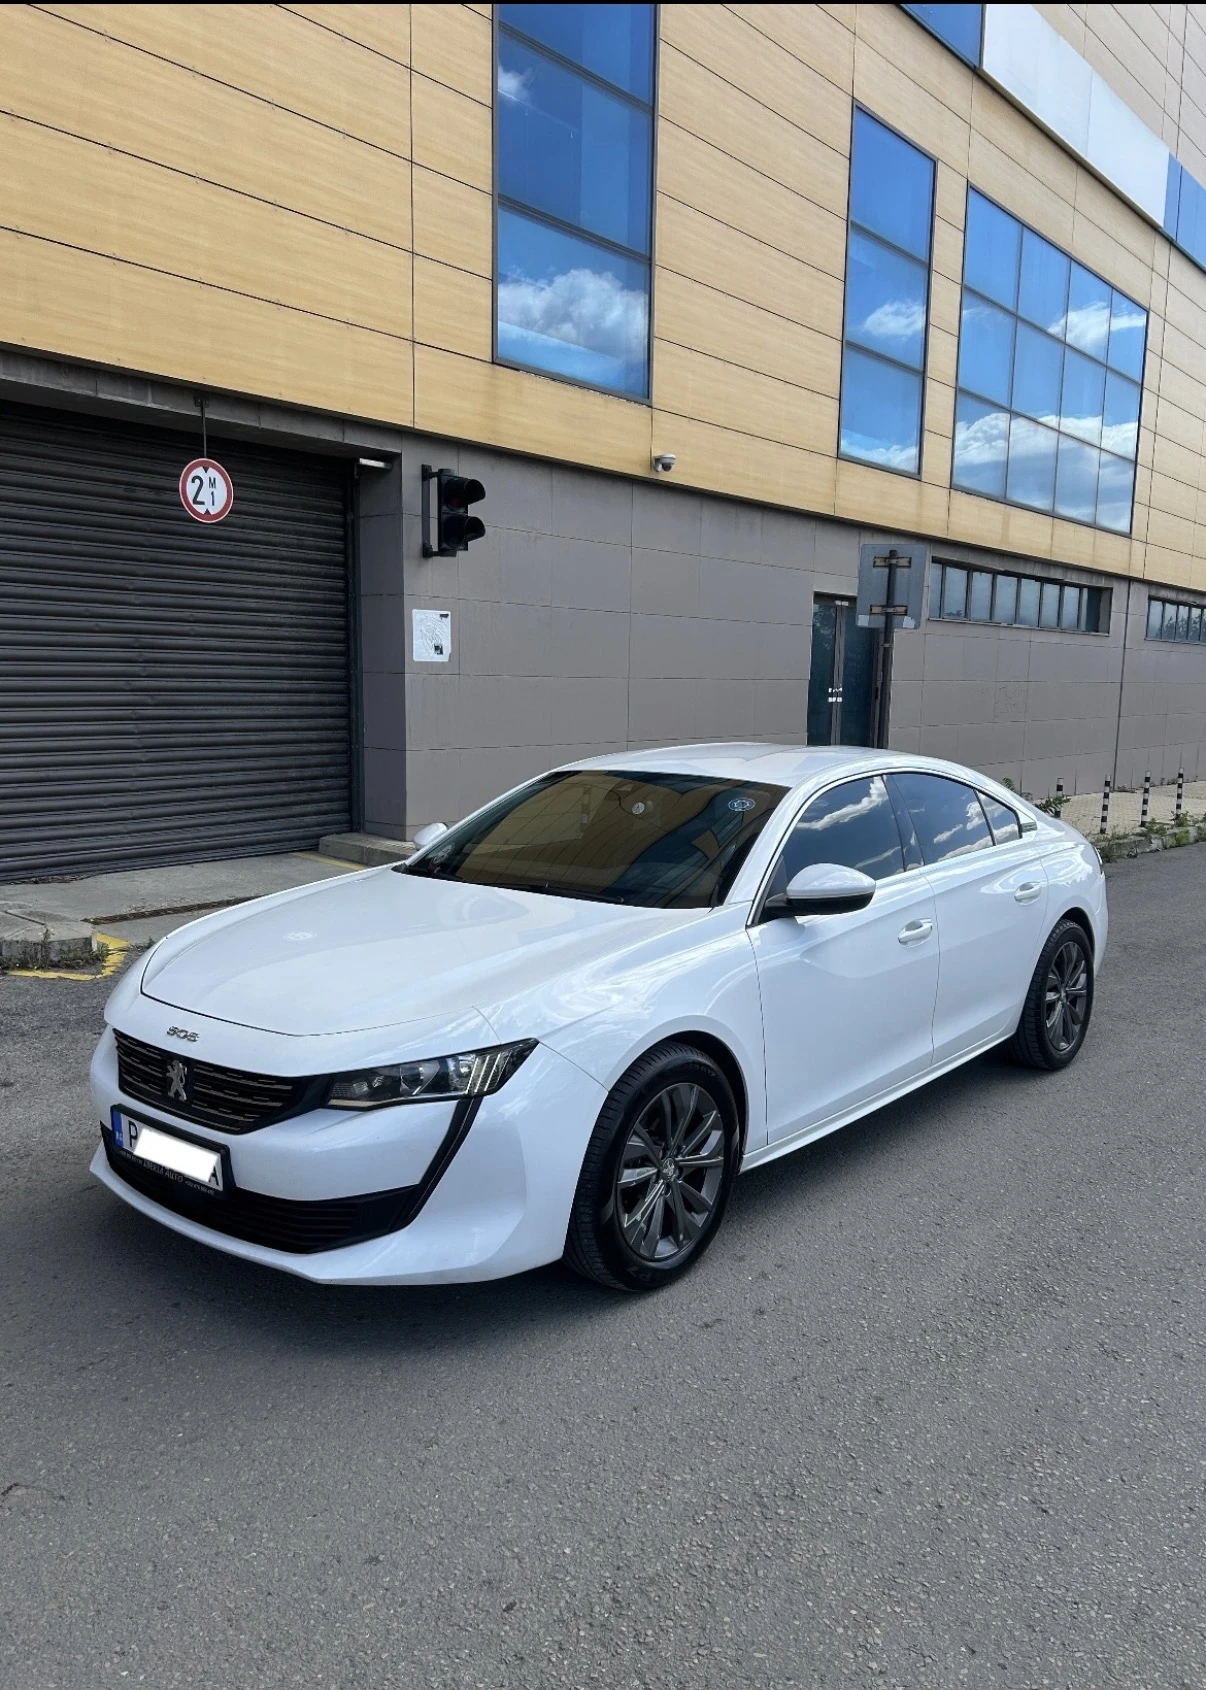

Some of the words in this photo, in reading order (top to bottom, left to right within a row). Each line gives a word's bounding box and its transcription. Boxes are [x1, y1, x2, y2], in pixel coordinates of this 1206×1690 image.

[191, 475, 205, 505] 2
[209, 476, 216, 489] M
[211, 491, 215, 506] 1
[128, 1120, 138, 1147] P
